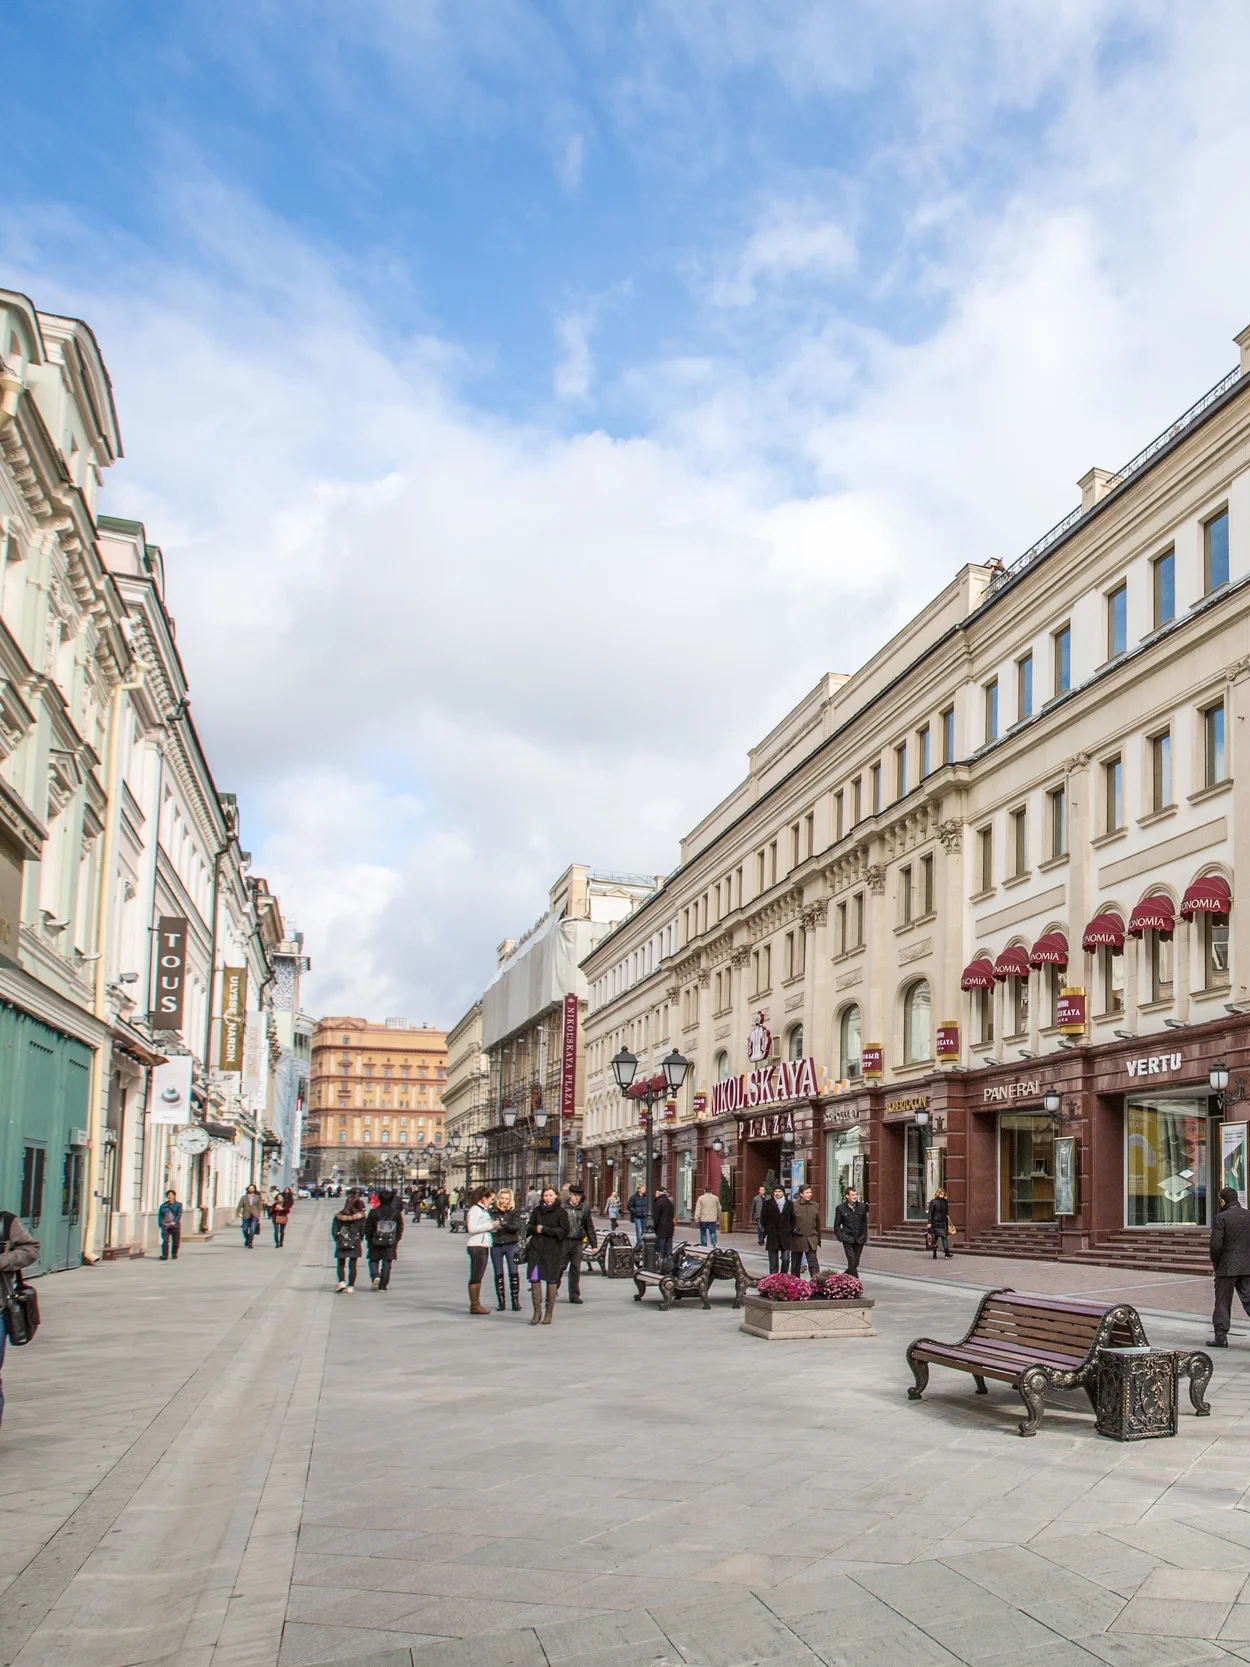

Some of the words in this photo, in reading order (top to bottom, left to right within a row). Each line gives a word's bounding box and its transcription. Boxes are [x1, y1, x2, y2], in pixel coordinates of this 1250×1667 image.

[161, 932, 181, 1013] TOUS
[228, 976, 239, 1014] ULYSSE
[226, 1023, 237, 1062] NARDIN
[1126, 1052, 1182, 1077] VERTU
[563, 1074, 573, 1105] PLAZA
[983, 1080, 1040, 1102] PANERAI
[738, 1112, 794, 1139] PLAZA
